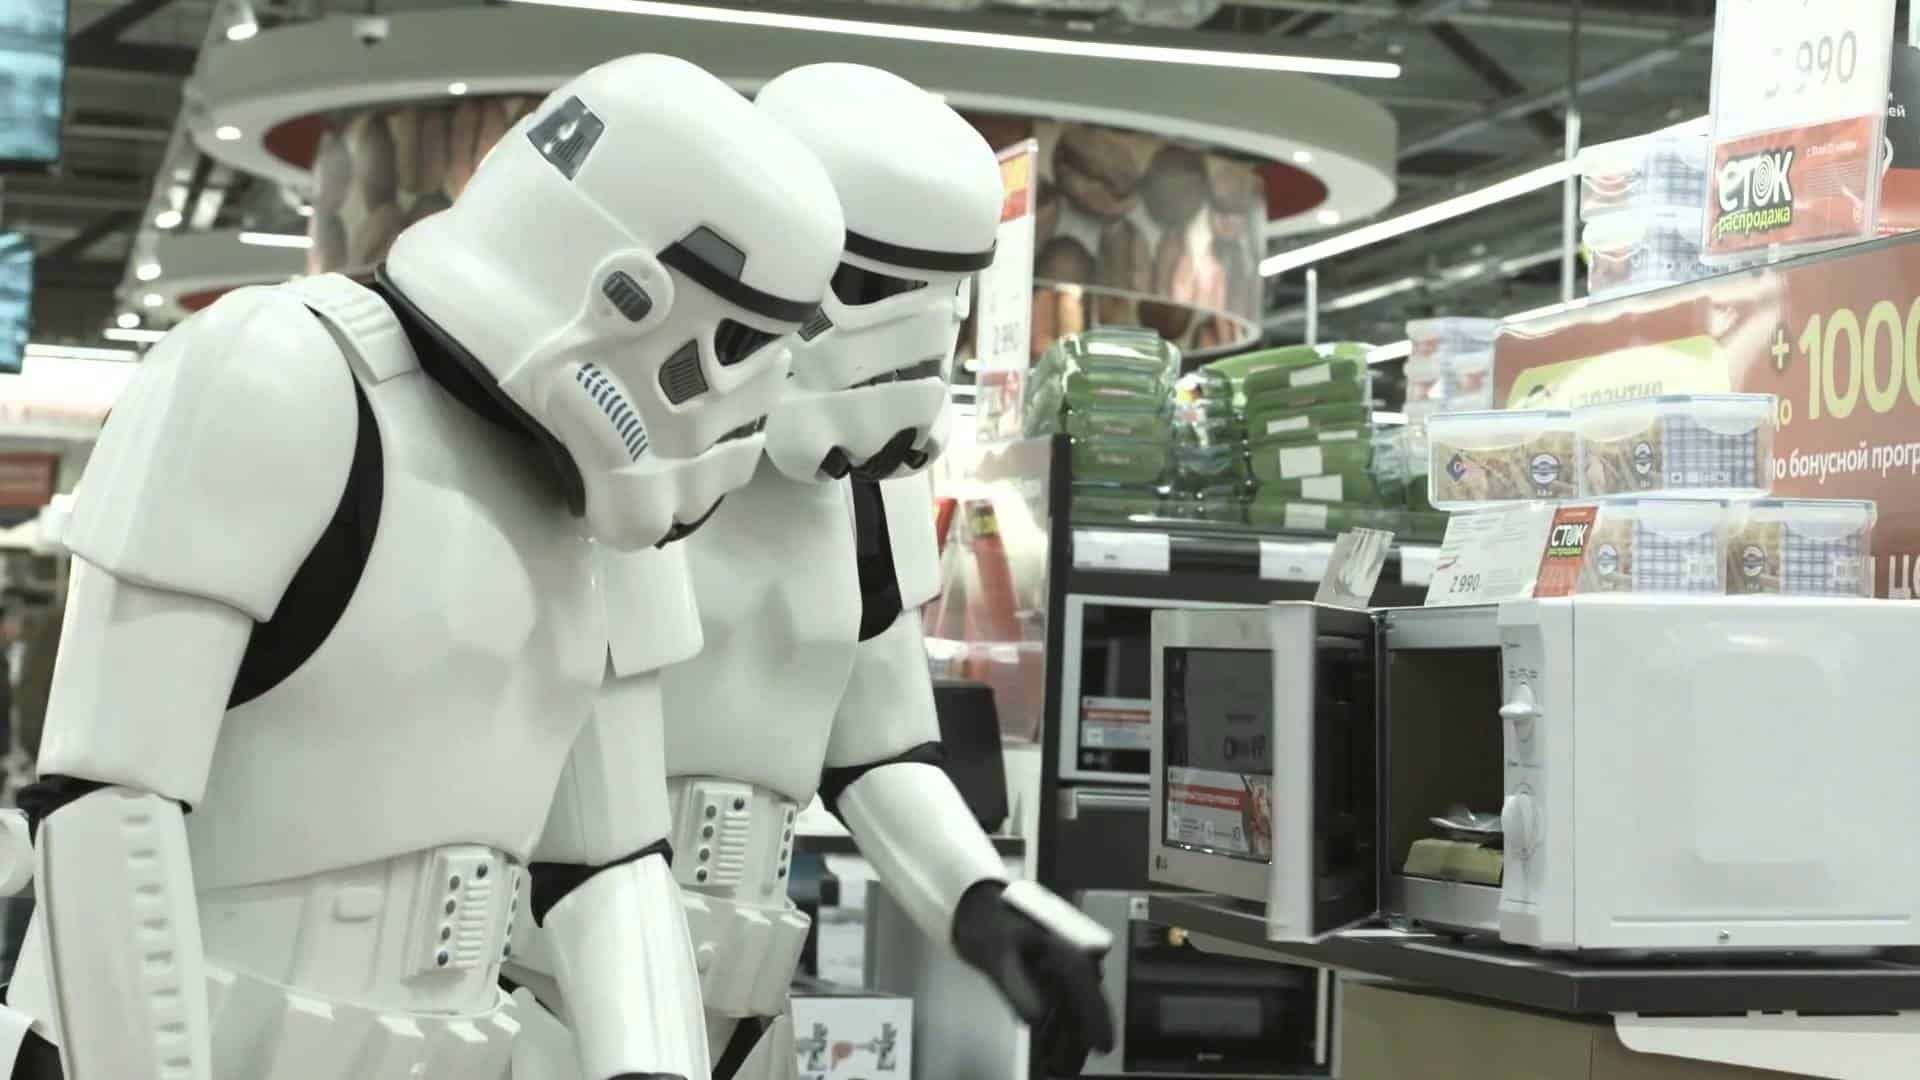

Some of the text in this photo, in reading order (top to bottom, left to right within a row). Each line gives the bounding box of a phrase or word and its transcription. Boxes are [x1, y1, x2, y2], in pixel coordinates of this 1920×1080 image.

[1717, 205, 1791, 240] распродажа
[1790, 440, 1868, 485] бонусной
[1551, 524, 1588, 547] СТОК
